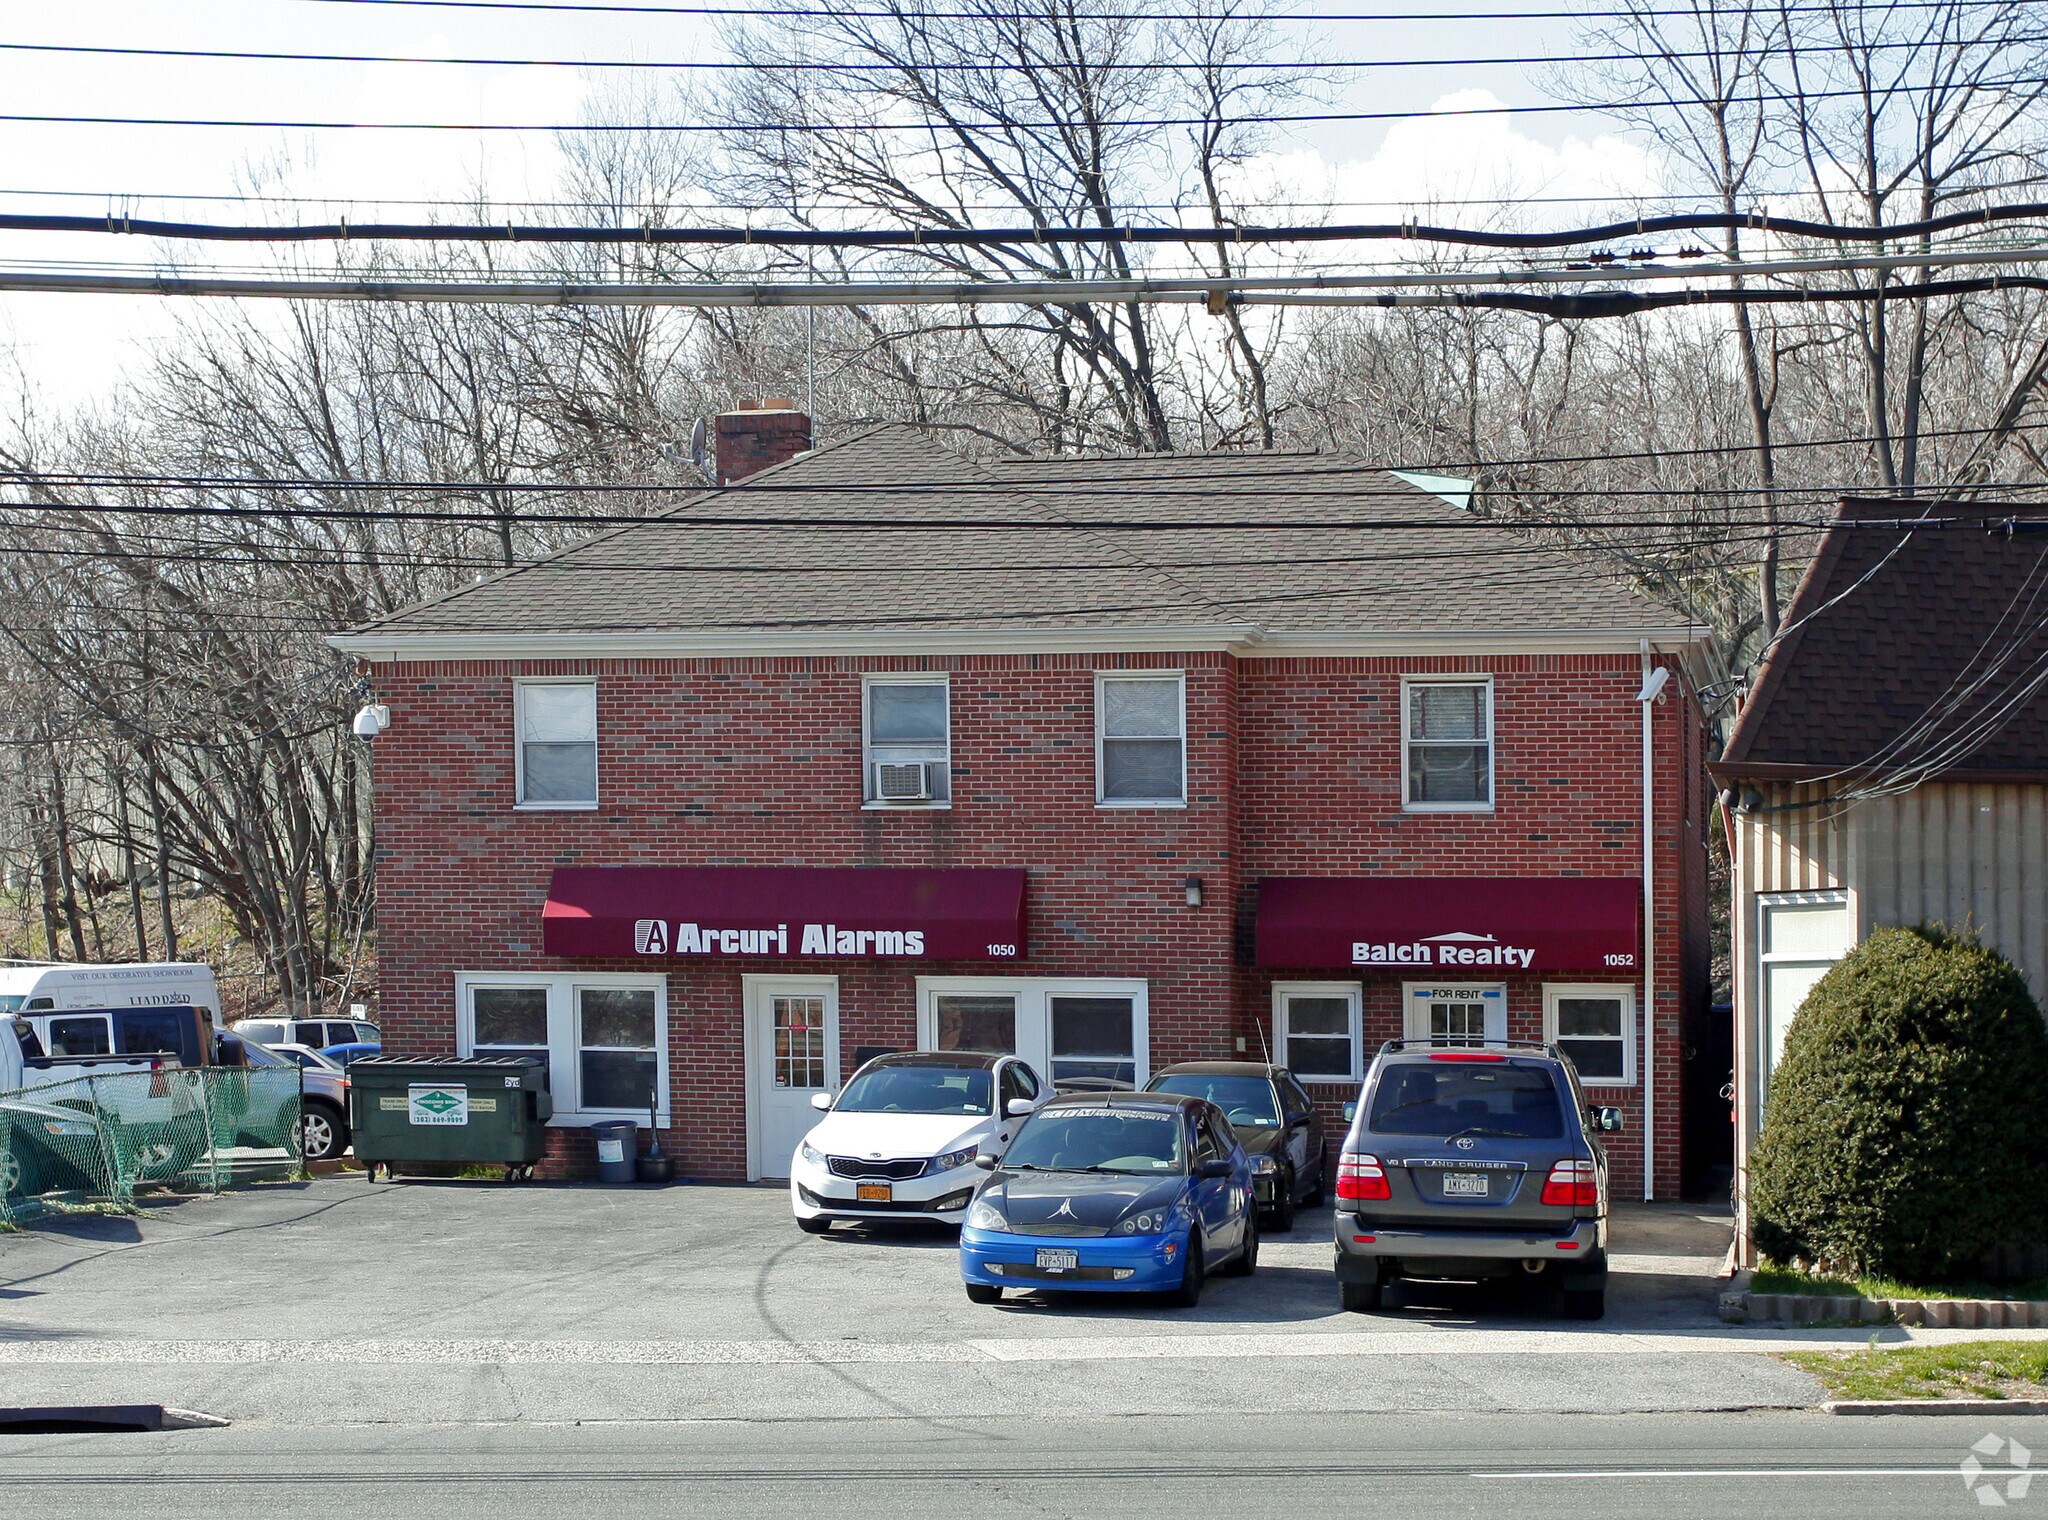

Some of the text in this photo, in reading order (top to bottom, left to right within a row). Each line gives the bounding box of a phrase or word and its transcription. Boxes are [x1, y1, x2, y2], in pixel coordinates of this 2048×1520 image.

[676, 923, 925, 956] Arcuri Alarms
[986, 944, 1016, 957] 1050
[1352, 942, 1536, 968] Balch Realty
[1603, 954, 1634, 966] 1052
[71, 969, 193, 981] VISIT OUR DECORATIVE SHOWROOM
[1432, 989, 1481, 999] FOR RENT
[1424, 1160, 1508, 1169] LAND CRUISER
